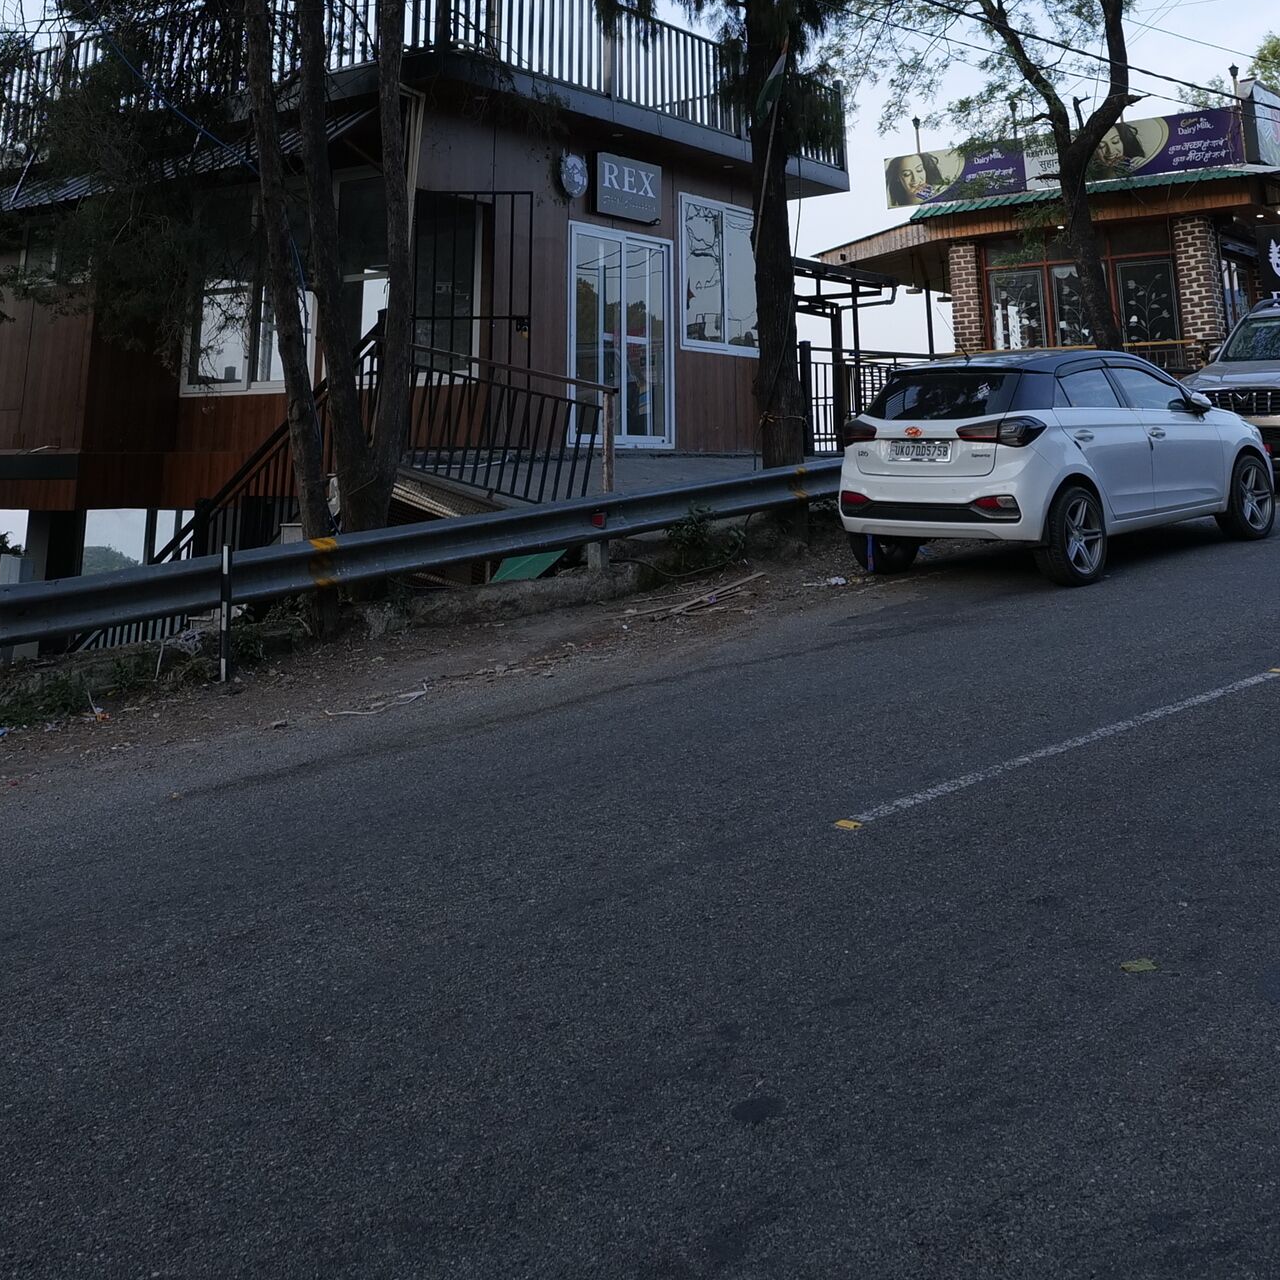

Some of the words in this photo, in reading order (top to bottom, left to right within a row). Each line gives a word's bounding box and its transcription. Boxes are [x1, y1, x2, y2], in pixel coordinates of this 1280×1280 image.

[1177, 126, 1197, 136] Dairy
[1196, 120, 1214, 131] Milk
[973, 155, 990, 165] Dairy
[1024, 148, 1058, 159] RESTAU
[602, 161, 657, 199] REX
